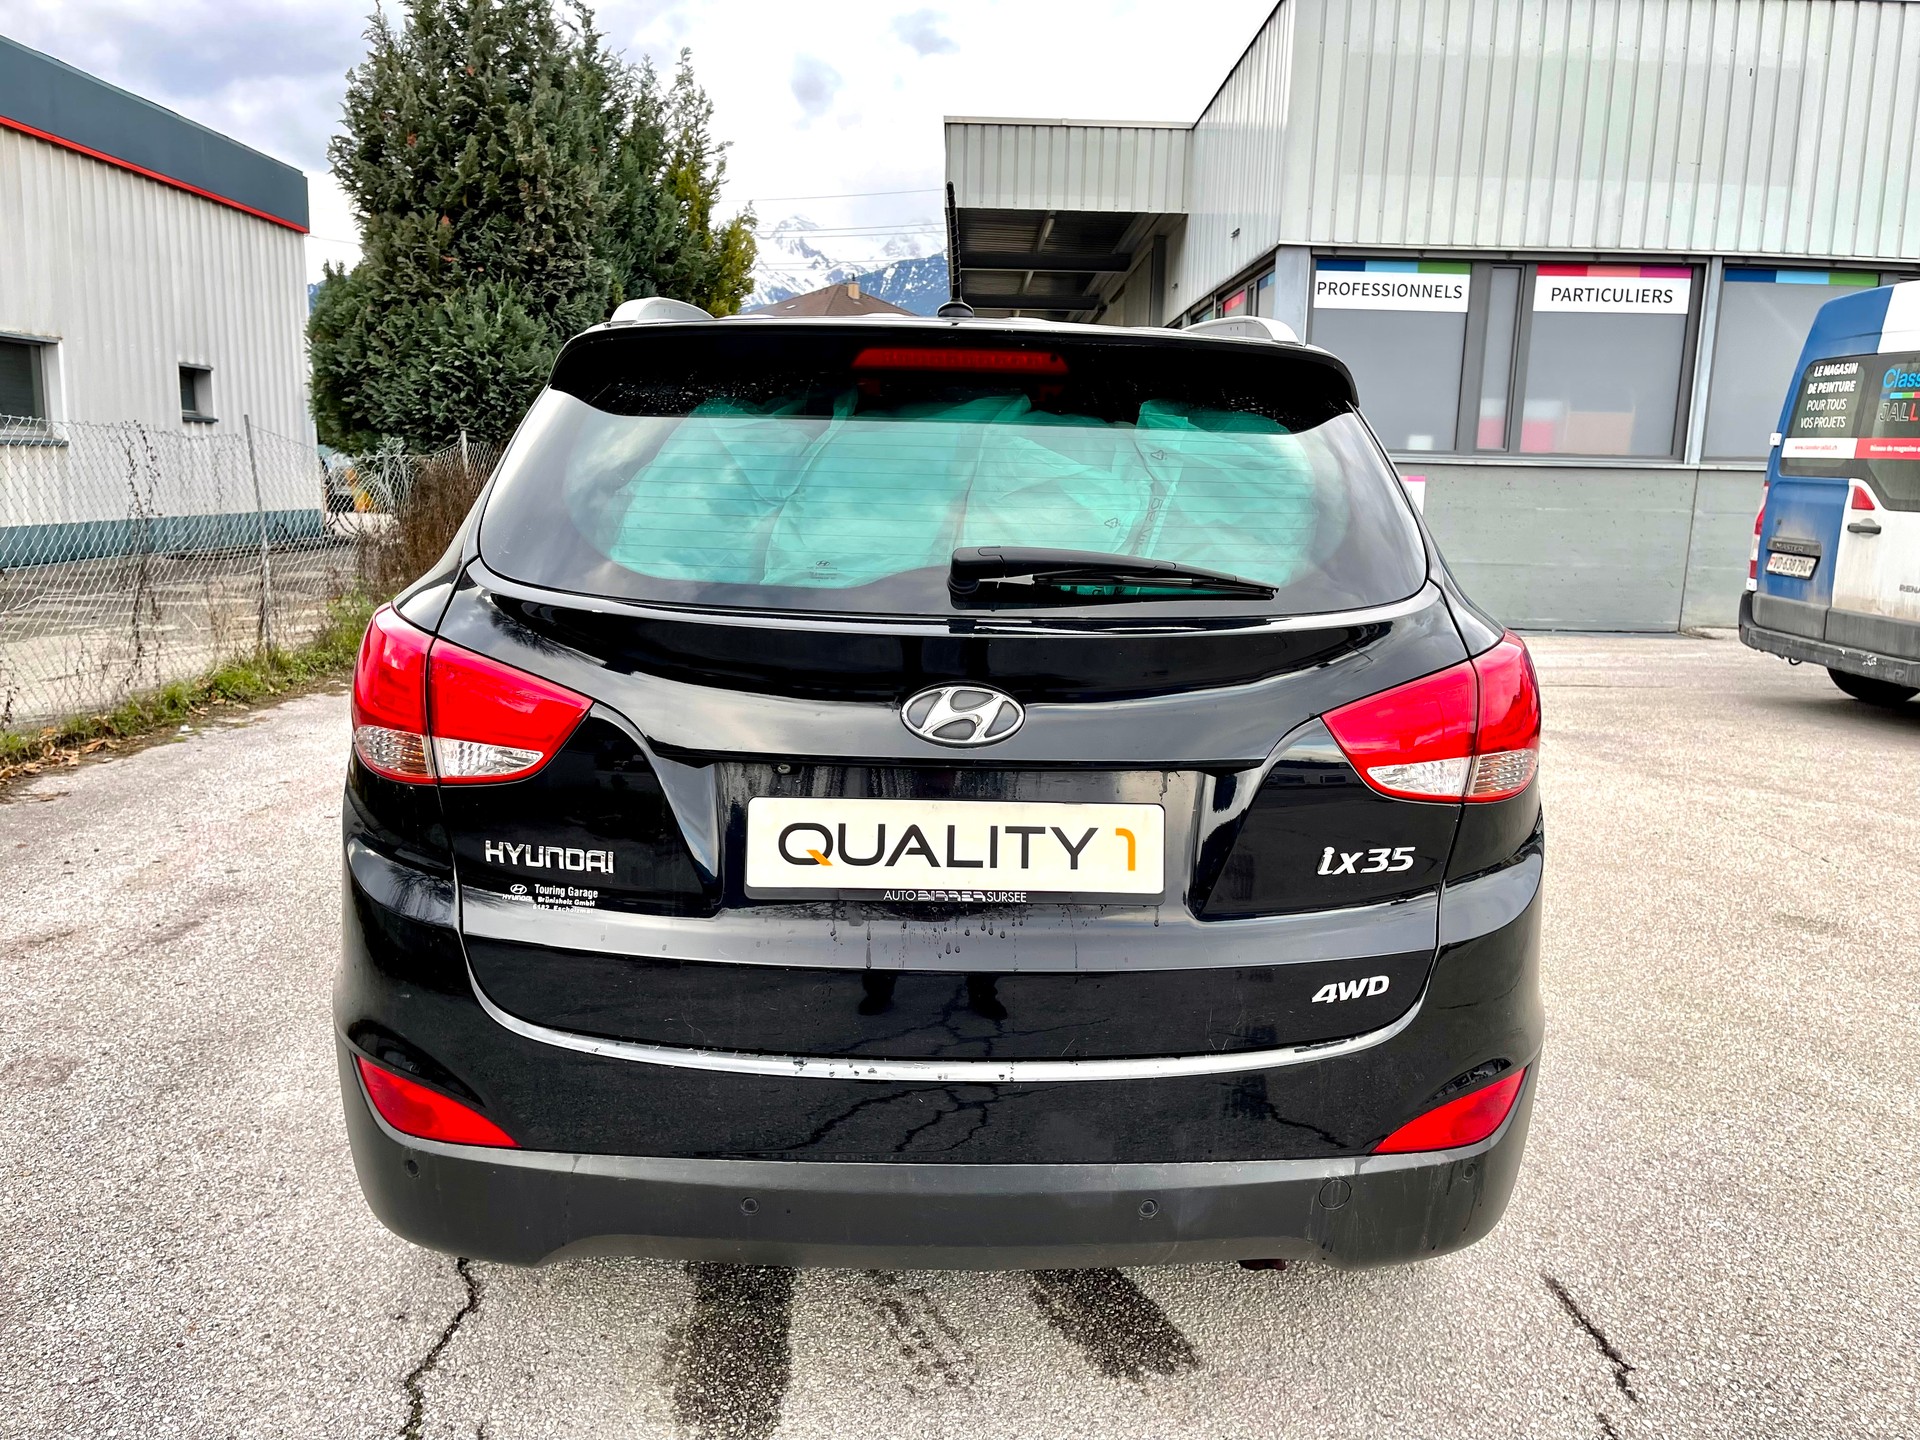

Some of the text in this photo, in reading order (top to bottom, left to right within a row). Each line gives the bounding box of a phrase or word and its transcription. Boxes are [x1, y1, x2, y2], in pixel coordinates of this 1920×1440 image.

[1317, 280, 1463, 299] PROFESSIONNELS
[1550, 286, 1674, 304] PARTICULIERS
[1814, 363, 1858, 377] LE MAGASIN
[1807, 380, 1856, 394] DE PEINTURE
[1806, 398, 1847, 411] POUR TOUS
[1800, 416, 1846, 428] VOS PROJETS
[778, 823, 1136, 871] QUALITY 1
[485, 840, 615, 874] HYUNDAI
[1318, 846, 1417, 876] ix35
[534, 884, 599, 899] Touring Garage
[883, 890, 916, 901] AUTO
[986, 891, 1027, 903] SURSEE
[1311, 975, 1390, 1004] 4WD
